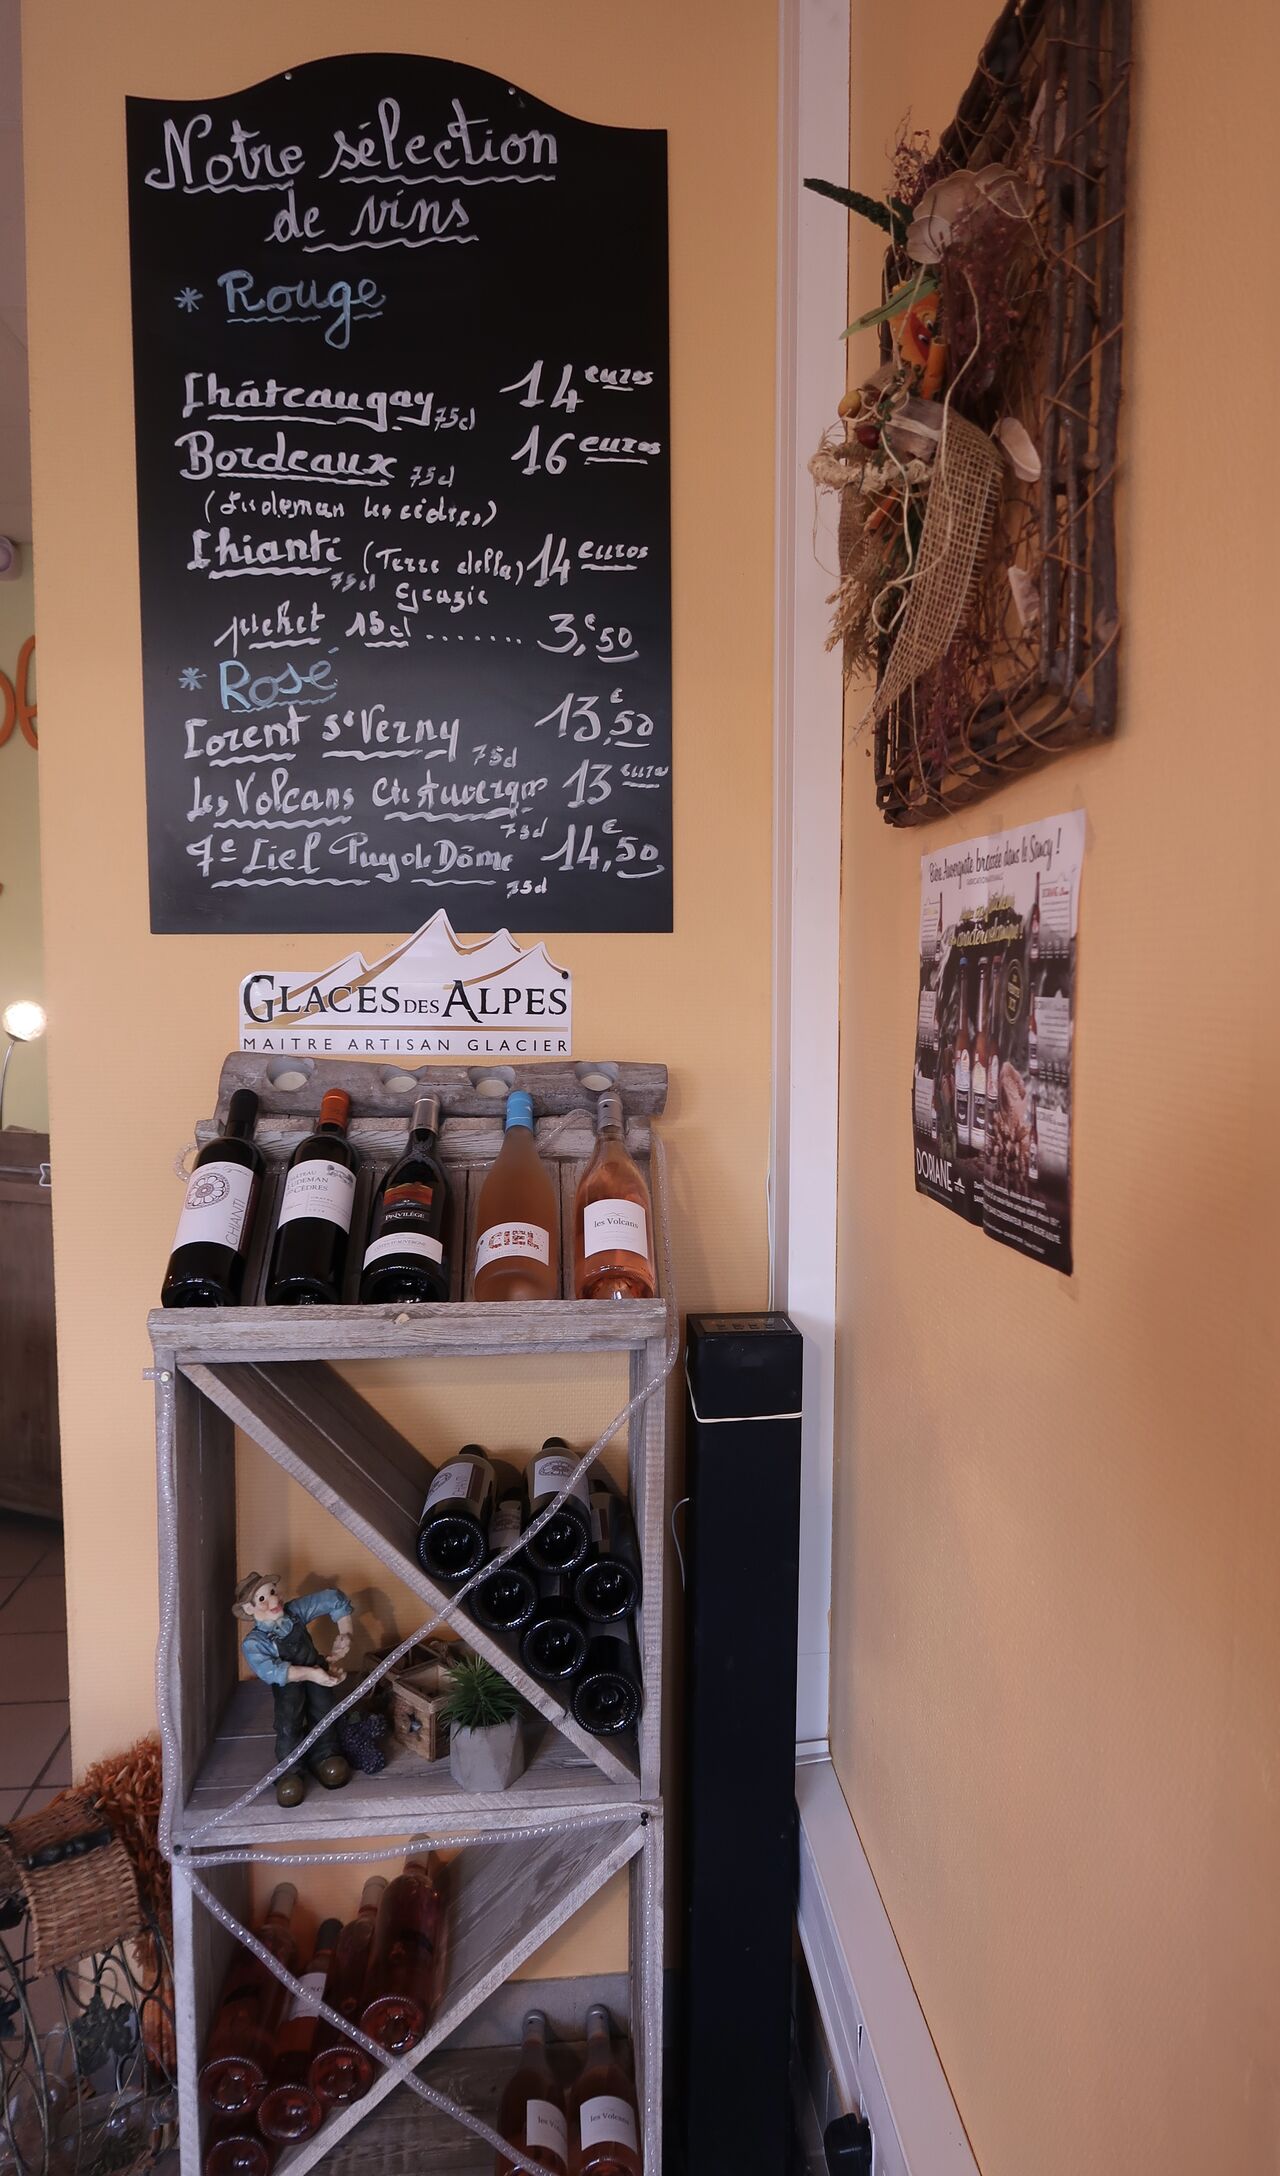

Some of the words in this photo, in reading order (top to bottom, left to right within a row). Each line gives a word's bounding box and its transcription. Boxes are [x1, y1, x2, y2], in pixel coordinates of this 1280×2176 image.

[145, 114, 306, 190] Notre
[319, 97, 558, 179] sélection
[264, 189, 326, 243] de
[350, 191, 470, 236] vins
[216, 269, 386, 349] Rouge
[434, 406, 476, 432] 75cl
[499, 360, 585, 413] 14
[585, 365, 654, 385] euros
[174, 430, 398, 481] Bordeaux
[410, 465, 455, 488] 75cl
[510, 425, 576, 475] 16
[579, 436, 662, 455] euros
[186, 526, 342, 570] Chianti
[526, 533, 571, 587] 14
[577, 541, 649, 560] euros
[214, 600, 326, 659] pichet
[345, 611, 412, 637] 15cl
[219, 646, 340, 709] Rosé
[184, 704, 312, 760] Corent
[360, 704, 460, 762] Verny
[471, 744, 518, 768] 75cl
[235, 767, 355, 815] Volcans
[562, 759, 613, 808] 13
[242, 832, 322, 875] Ciel
[431, 840, 514, 875] Dôme
[243, 975, 400, 1023] GLACES
[404, 1000, 440, 1014] DES
[441, 980, 568, 1023] ALPES
[243, 1038, 333, 1051] MAITRE
[348, 1039, 450, 1051] ARTISAN
[468, 1039, 568, 1052] GLACIER
[916, 1148, 953, 1193] DORIANE
[225, 1198, 246, 1246] CHIANTI
[594, 1220, 606, 1228] les
[607, 1218, 639, 1229] Volcans
